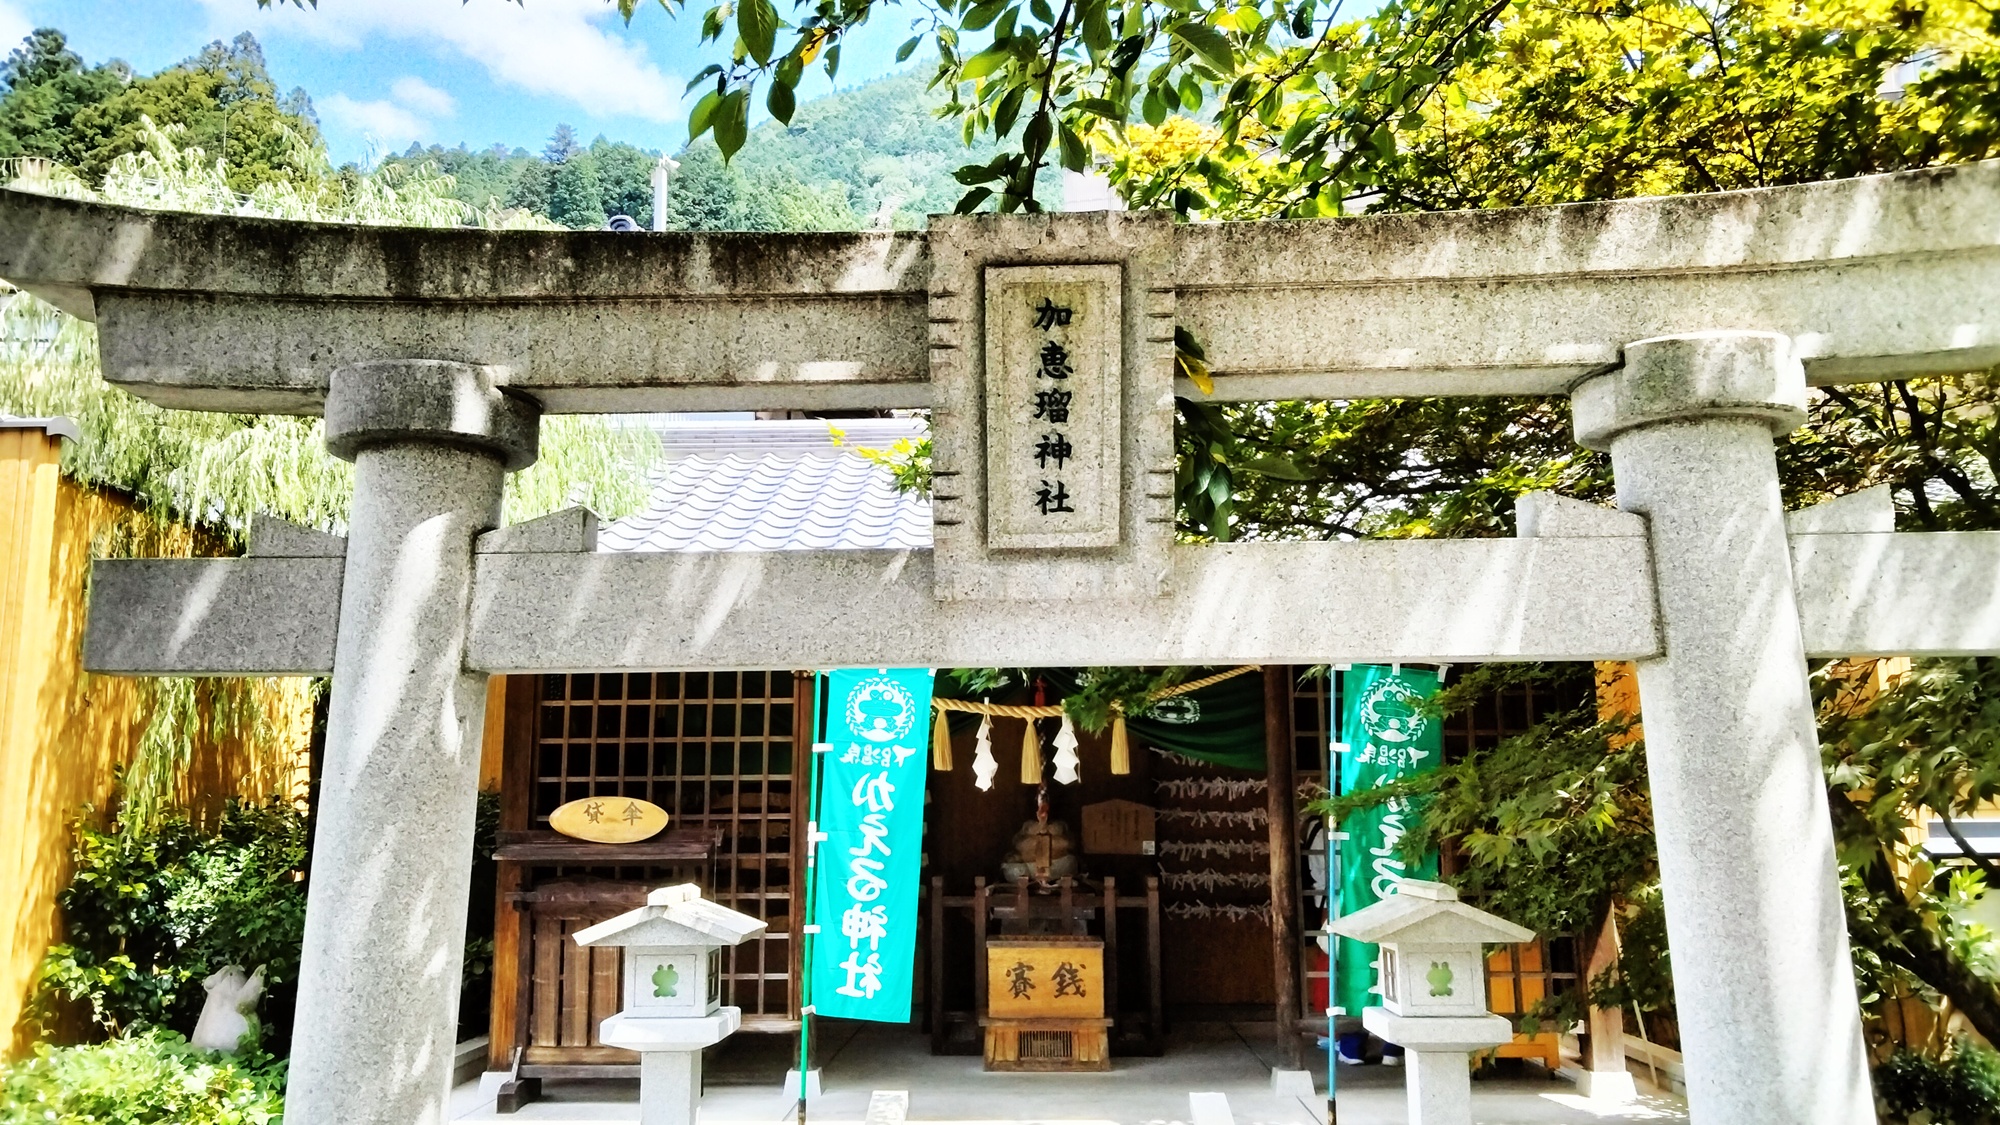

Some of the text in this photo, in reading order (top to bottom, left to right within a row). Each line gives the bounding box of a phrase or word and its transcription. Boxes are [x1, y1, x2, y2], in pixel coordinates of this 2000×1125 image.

[1032, 297, 1075, 516] 加恵瑠神社
[583, 801, 644, 826] 貸傘
[1005, 961, 1087, 1001] 賽銭
